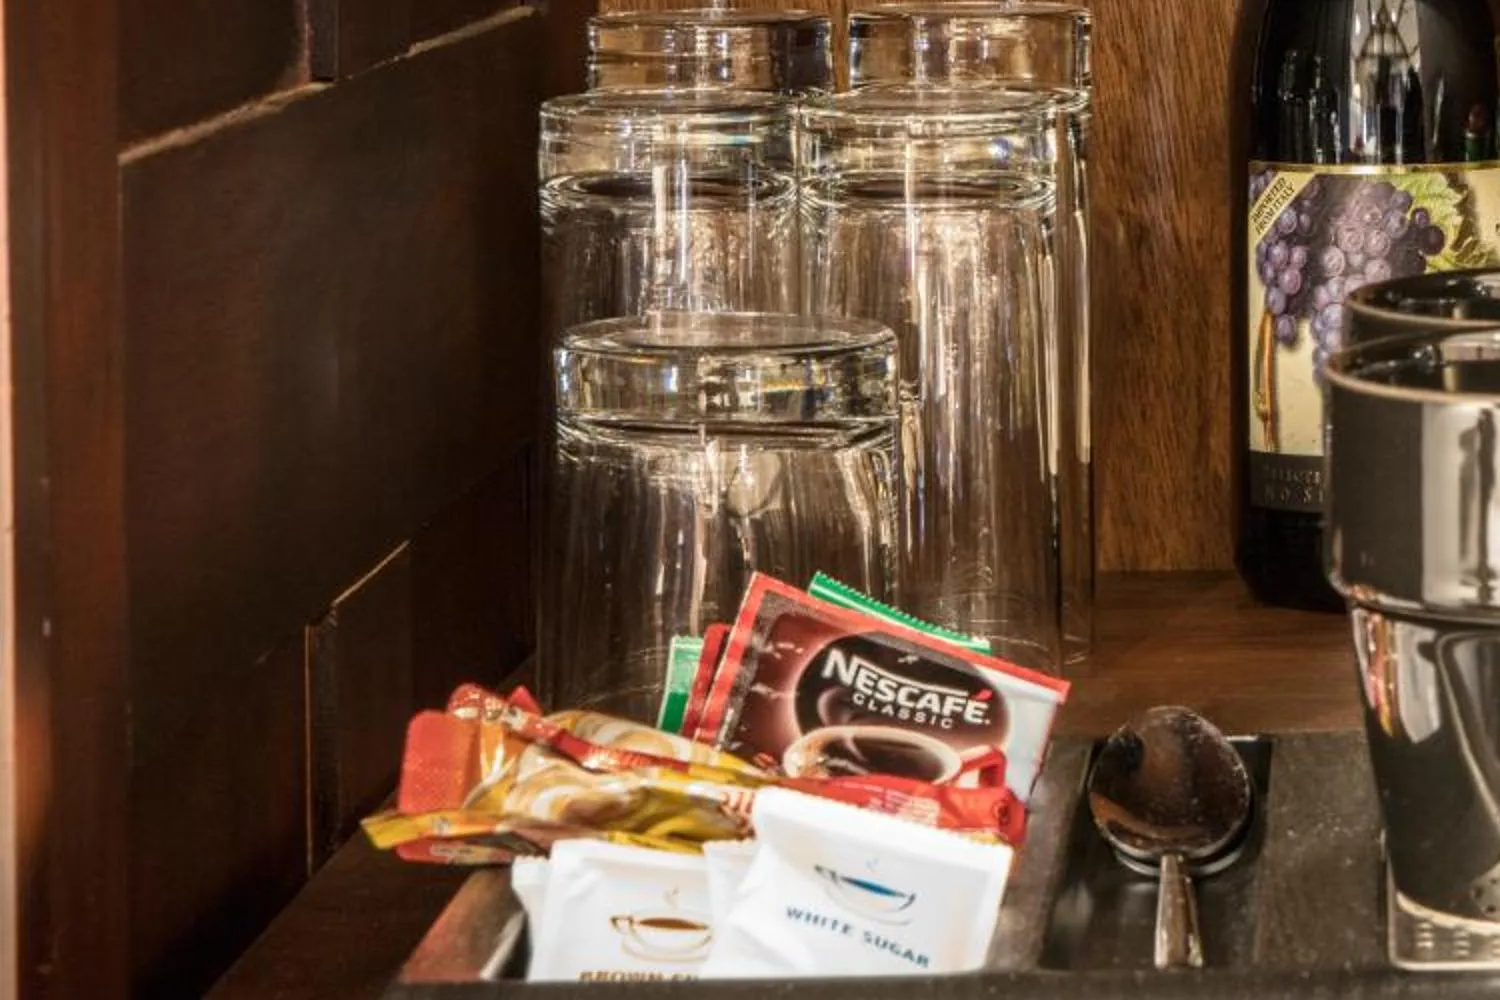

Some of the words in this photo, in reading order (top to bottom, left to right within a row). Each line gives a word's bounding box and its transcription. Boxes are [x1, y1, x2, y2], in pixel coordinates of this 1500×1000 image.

[852, 692, 953, 729] CLASSIC
[786, 907, 851, 934] WHITE
[863, 930, 929, 968] SUGAR
